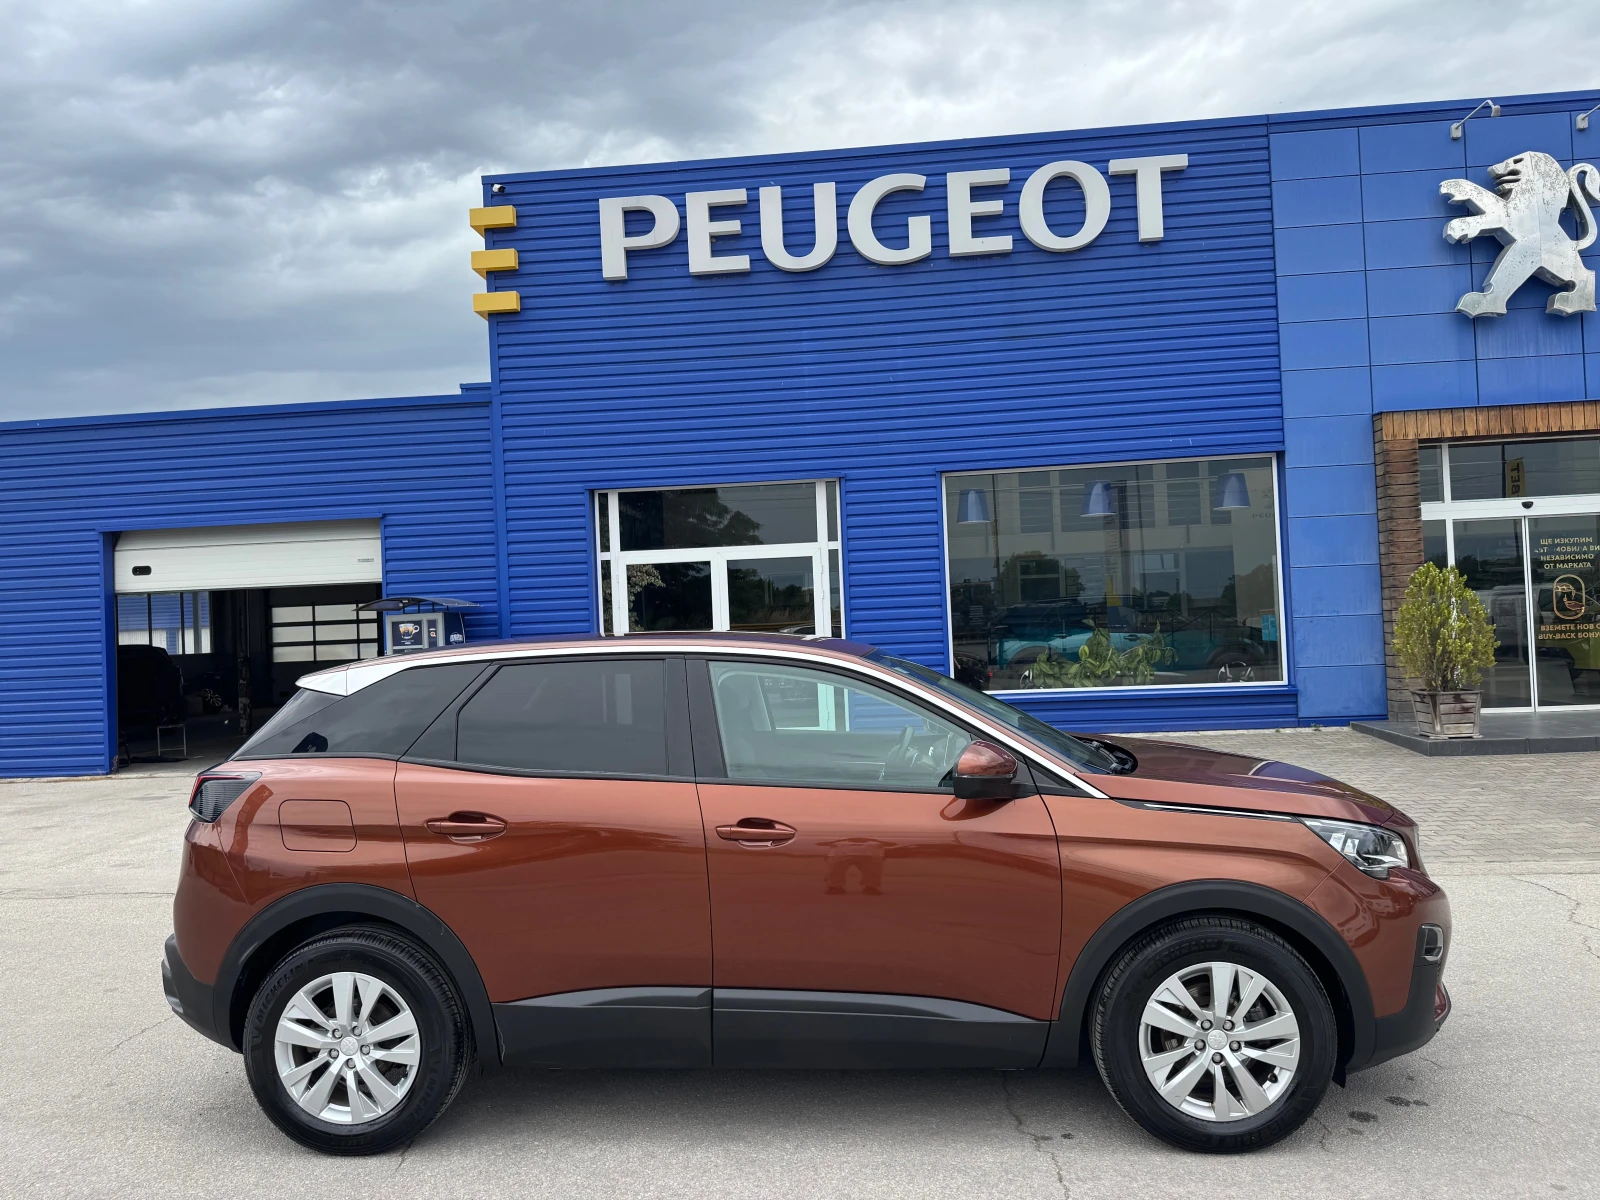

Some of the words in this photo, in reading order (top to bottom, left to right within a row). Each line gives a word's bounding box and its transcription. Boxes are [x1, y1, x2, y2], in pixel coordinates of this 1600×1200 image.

[598, 153, 1189, 281] PEUGEOT
[1554, 536, 1593, 544] ИЗКУПИМ
[1540, 553, 1594, 561] НЕЗАВИСИМО
[1538, 632, 1576, 640] BUY-BACK
[1577, 631, 1600, 639] БОНУ
[256, 961, 306, 1026] MICHELIN
